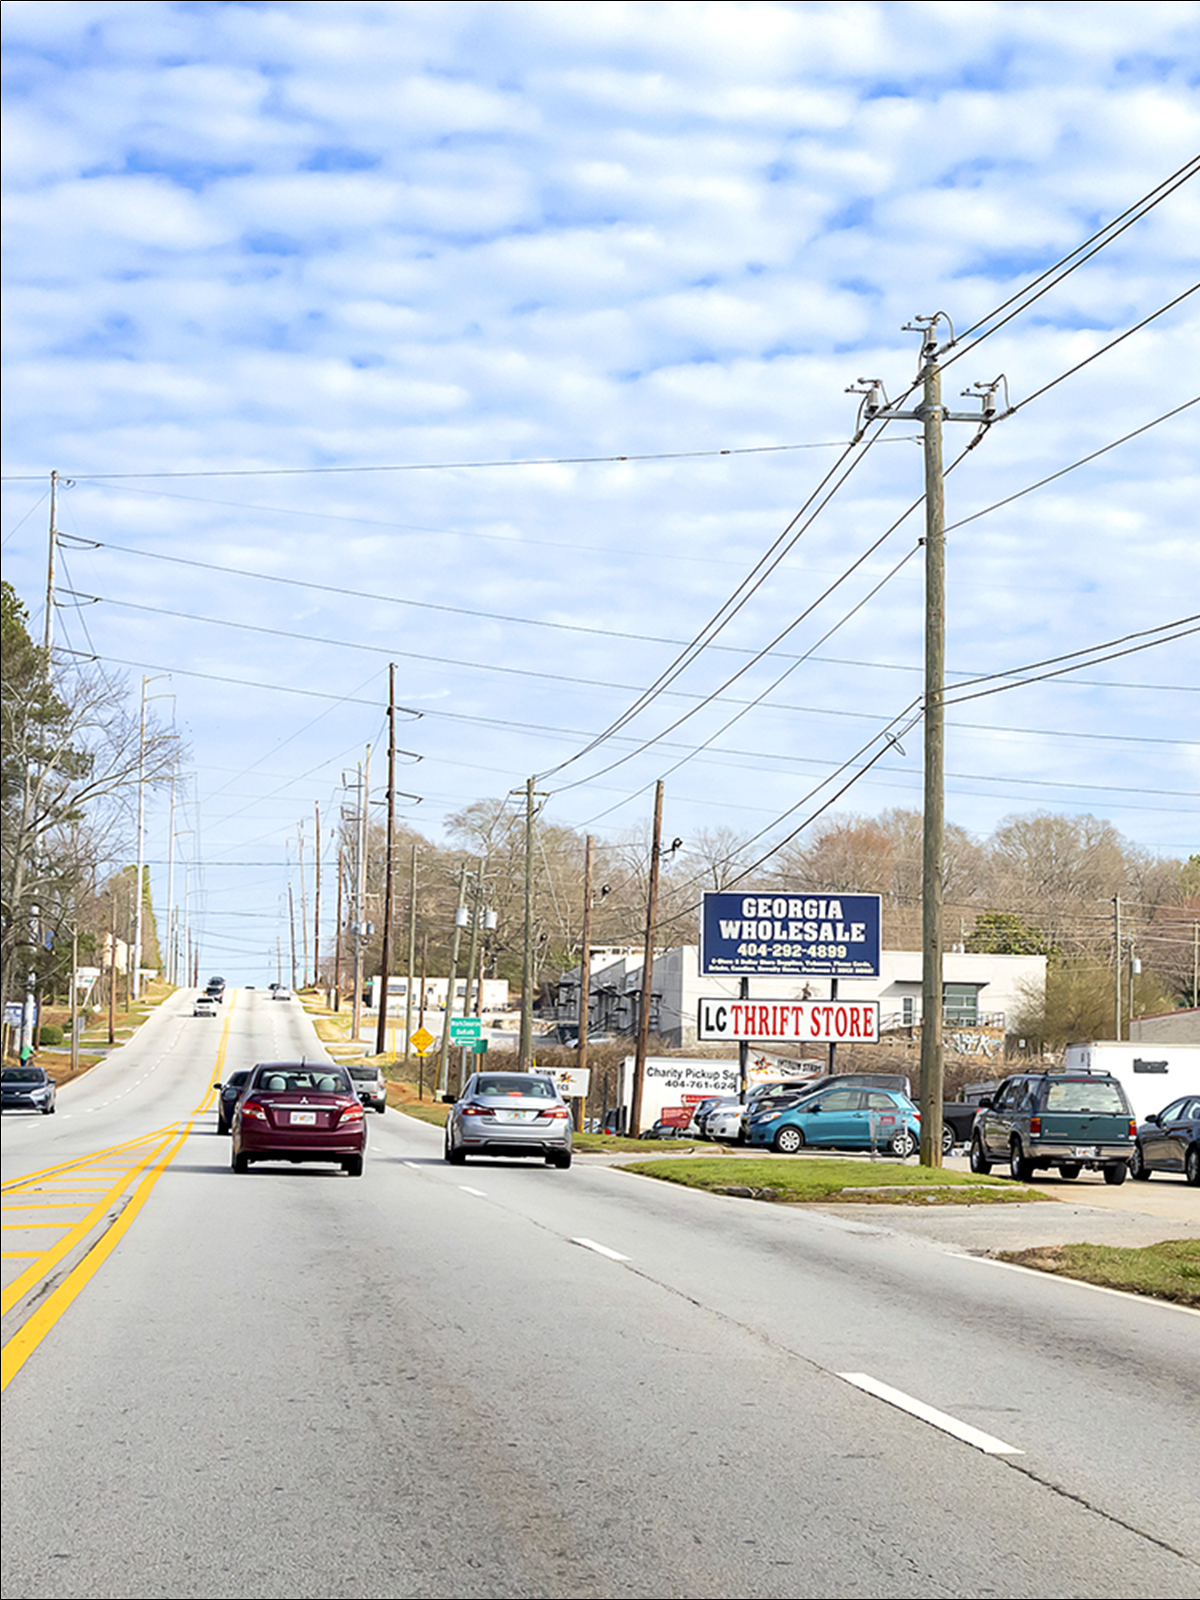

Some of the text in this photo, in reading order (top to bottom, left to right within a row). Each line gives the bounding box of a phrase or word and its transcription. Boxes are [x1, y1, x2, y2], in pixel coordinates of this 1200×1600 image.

[742, 897, 844, 919] GEORGIA
[719, 920, 866, 942] WHOLESALE
[737, 942, 847, 959] 404-292-4899
[705, 1005, 874, 1038] LC THRIFT STORE
[646, 1066, 684, 1081] Charity
[685, 1067, 721, 1082] Pickup
[664, 1079, 737, 1091] 404-761-624
